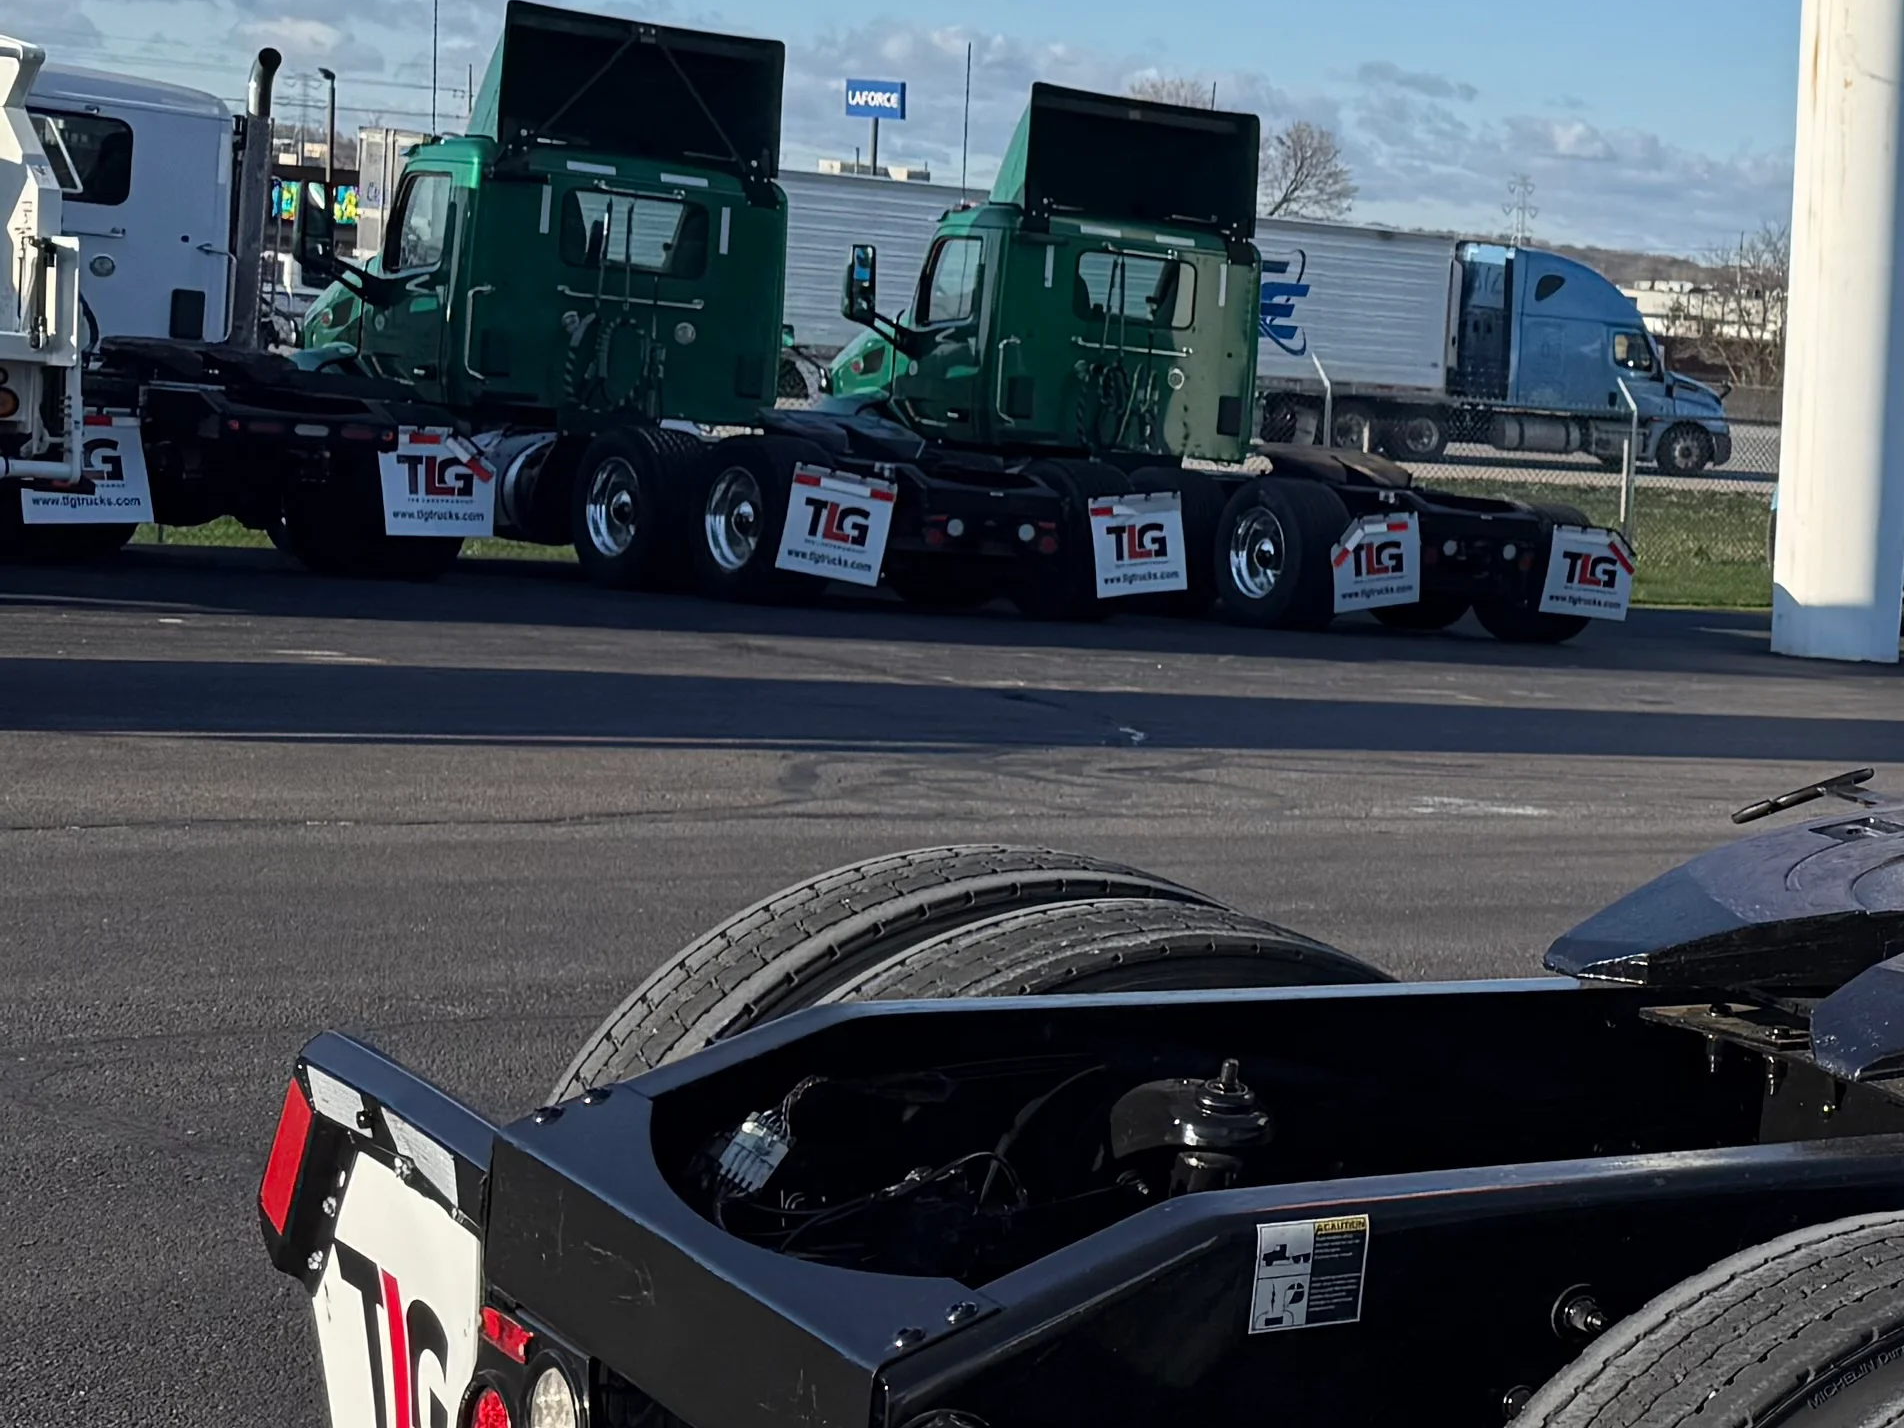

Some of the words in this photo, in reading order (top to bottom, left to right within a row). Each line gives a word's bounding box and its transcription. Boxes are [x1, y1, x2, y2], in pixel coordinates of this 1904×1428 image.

[848, 90, 898, 108] LAFORCE
[397, 455, 474, 497] TLG
[805, 496, 871, 548] TLG
[1106, 523, 1168, 561] TLG
[1352, 541, 1404, 577] TLG
[1562, 551, 1617, 588] TLG
[1807, 1359, 1877, 1409] MICHELIN
